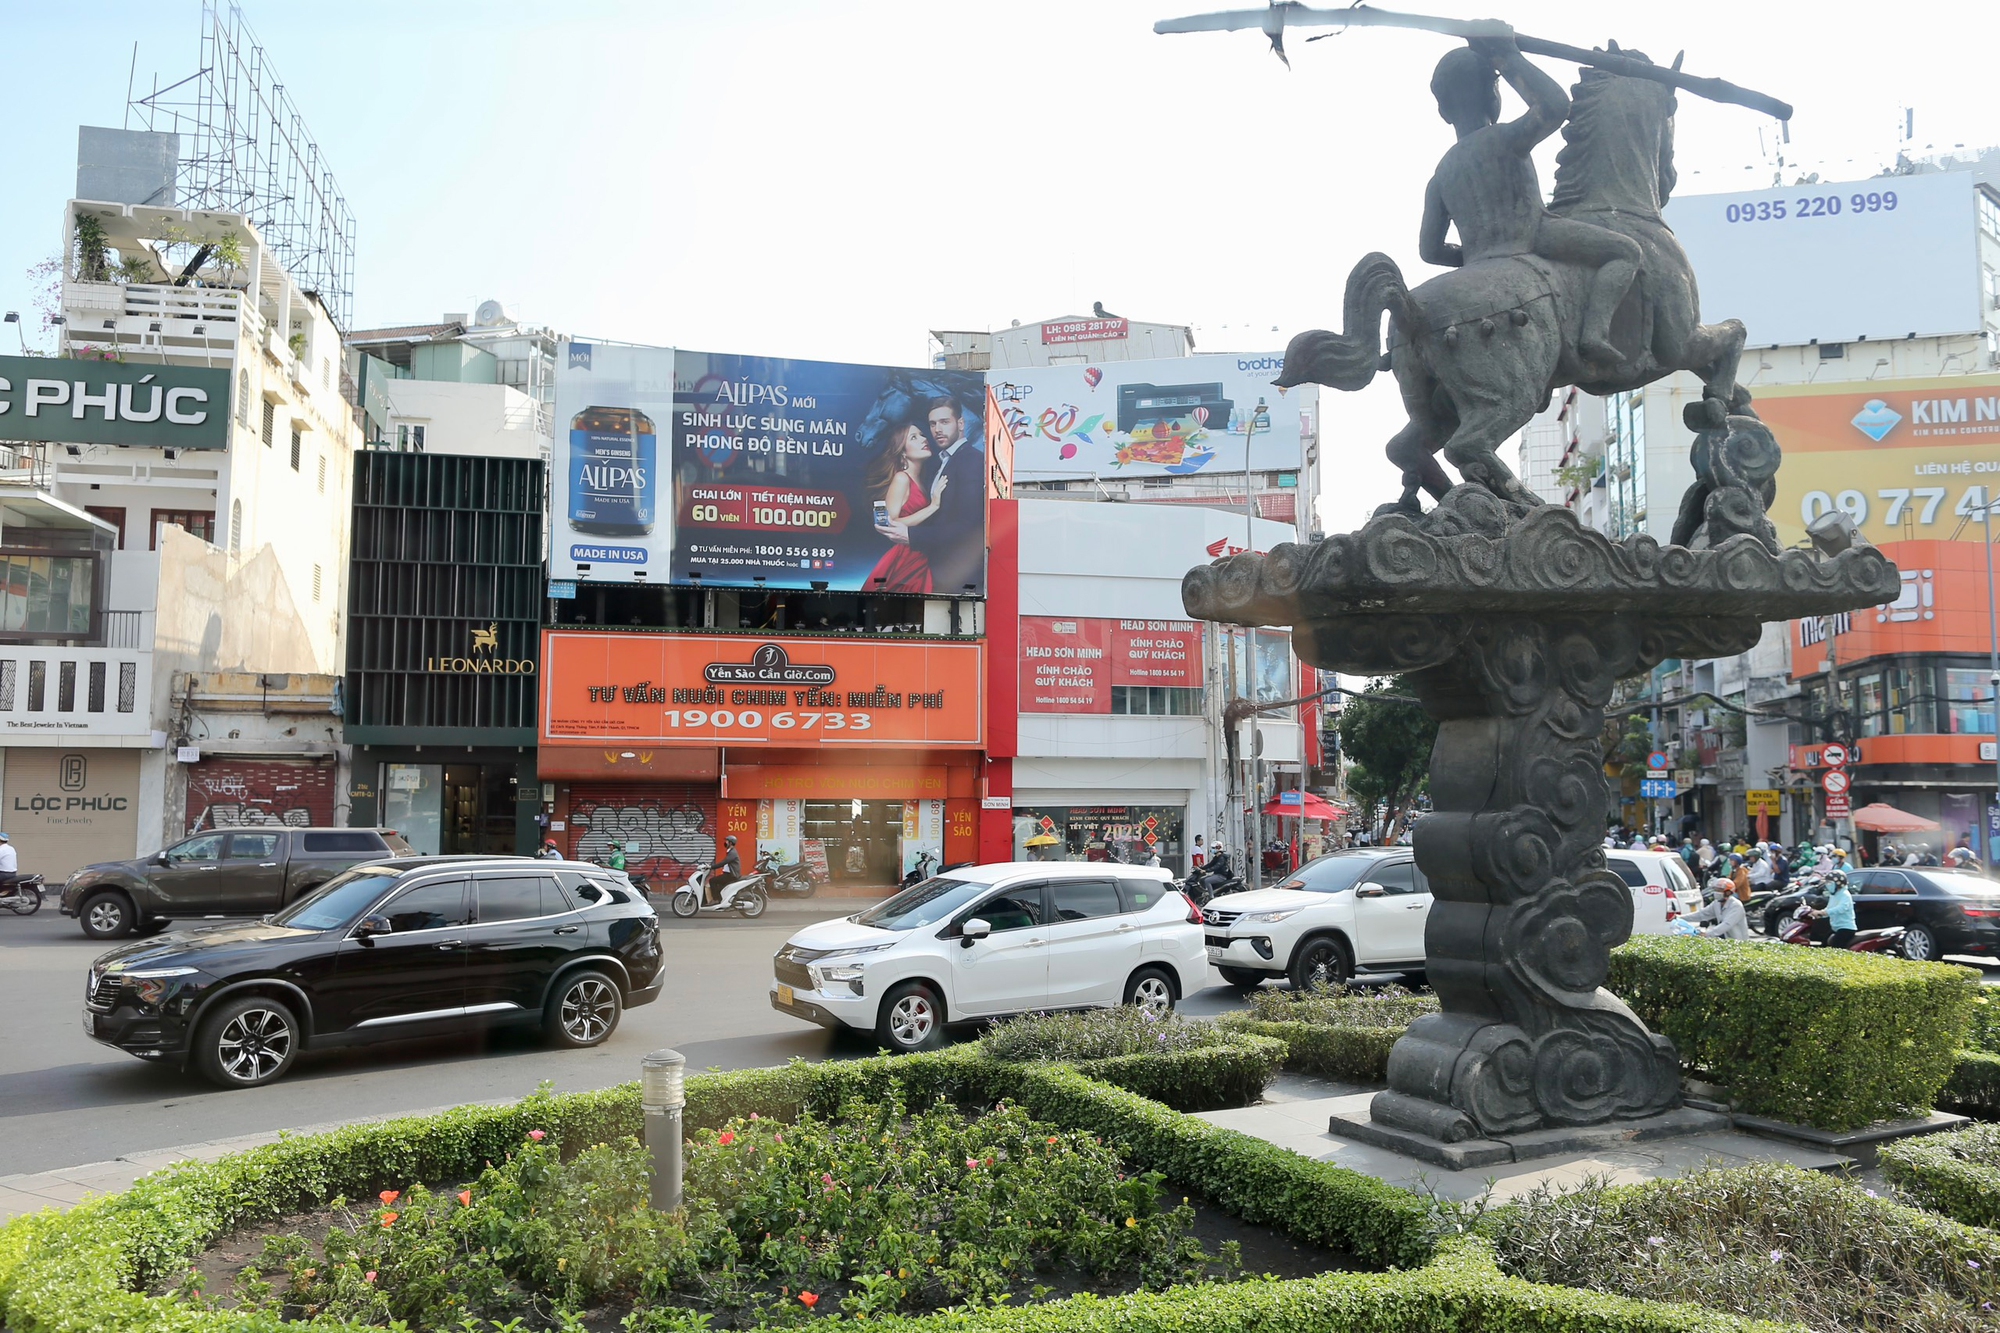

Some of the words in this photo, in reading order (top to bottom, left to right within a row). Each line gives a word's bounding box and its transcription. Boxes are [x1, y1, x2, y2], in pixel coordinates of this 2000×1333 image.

[1726, 200, 1787, 223] 0935
[1796, 195, 1842, 218] 220
[1850, 191, 1898, 213] 999
[1046, 325, 1061, 334] LH:
[1063, 323, 1086, 333] 0985
[1088, 322, 1103, 330] 281
[1105, 320, 1122, 329] 707
[1238, 357, 1285, 371] brothe
[25, 373, 208, 425] PHÚC
[792, 396, 816, 409] MỚI
[1911, 398, 1968, 424] KIM
[1975, 396, 2000, 421] N
[682, 412, 721, 428] SINH
[726, 413, 756, 432] LỰC
[760, 417, 804, 434] SUNG
[809, 418, 847, 436] MÃN
[686, 434, 743, 450] PHONG
[747, 435, 771, 455] ĐỘ
[776, 435, 808, 454] BỀN
[812, 439, 843, 456] LÂU
[1914, 462, 1947, 475] LIÊN
[1951, 460, 1971, 475] HỆ
[692, 489, 717, 499] CHAI
[720, 488, 742, 501] LỚN
[752, 491, 775, 503] TIẾT
[777, 493, 803, 506] KIỆM
[805, 494, 835, 506] NGAY
[692, 505, 718, 522] 60
[720, 512, 740, 522] VIÊN
[573, 547, 606, 559] MADE
[609, 548, 620, 560] IN
[623, 550, 645, 561] USA
[755, 545, 783, 556] 1800
[786, 546, 809, 557] 556
[811, 547, 835, 558] 889
[708, 557, 719, 565] TẠI
[762, 558, 785, 567] THUỐC
[1120, 620, 1145, 630] HEAD
[1147, 620, 1167, 631] SƠN
[1169, 621, 1194, 632] MINH
[1130, 637, 1153, 647] KÍNH
[1155, 638, 1184, 648] CHÀO
[1026, 646, 1052, 657] HEAD
[1054, 646, 1074, 658] SƠN
[1077, 648, 1102, 659] MINH
[1129, 649, 1149, 659] QUÝ
[1151, 649, 1186, 660] KHÁCH
[428, 657, 534, 674] LEONARDO
[1036, 664, 1060, 675] KÍNH
[1062, 665, 1092, 675] CHÀO
[709, 667, 731, 678] Yến
[735, 668, 755, 679] Sào
[759, 667, 780, 679] Cần
[1035, 675, 1056, 686] QUÝ
[1059, 676, 1093, 687] KHÁCH
[588, 685, 618, 703] TƯ
[623, 681, 665, 703] VẤN
[672, 684, 724, 705] NUÔI
[732, 689, 787, 706] CHIM
[848, 684, 901, 707] MIỄN
[908, 689, 944, 709] PHÍ
[1035, 696, 1055, 704] Hotline
[34, 721, 55, 729] Jeweler
[664, 709, 763, 729] 1900
[771, 711, 872, 730] 6733
[14, 793, 61, 815] LỘC
[66, 793, 128, 811] PHÚC
[728, 803, 747, 817] YẾN
[47, 816, 63, 824] Fine
[65, 816, 93, 826] Jewelry
[953, 808, 972, 822] YẾN
[727, 819, 748, 832] SÀO
[760, 813, 769, 838] Cháo
[904, 820, 914, 838] Chè
[953, 824, 972, 837] SÀO
[1069, 822, 1082, 830] TẾT
[1083, 822, 1099, 831] VIỆT
[1102, 823, 1143, 842] 2023
